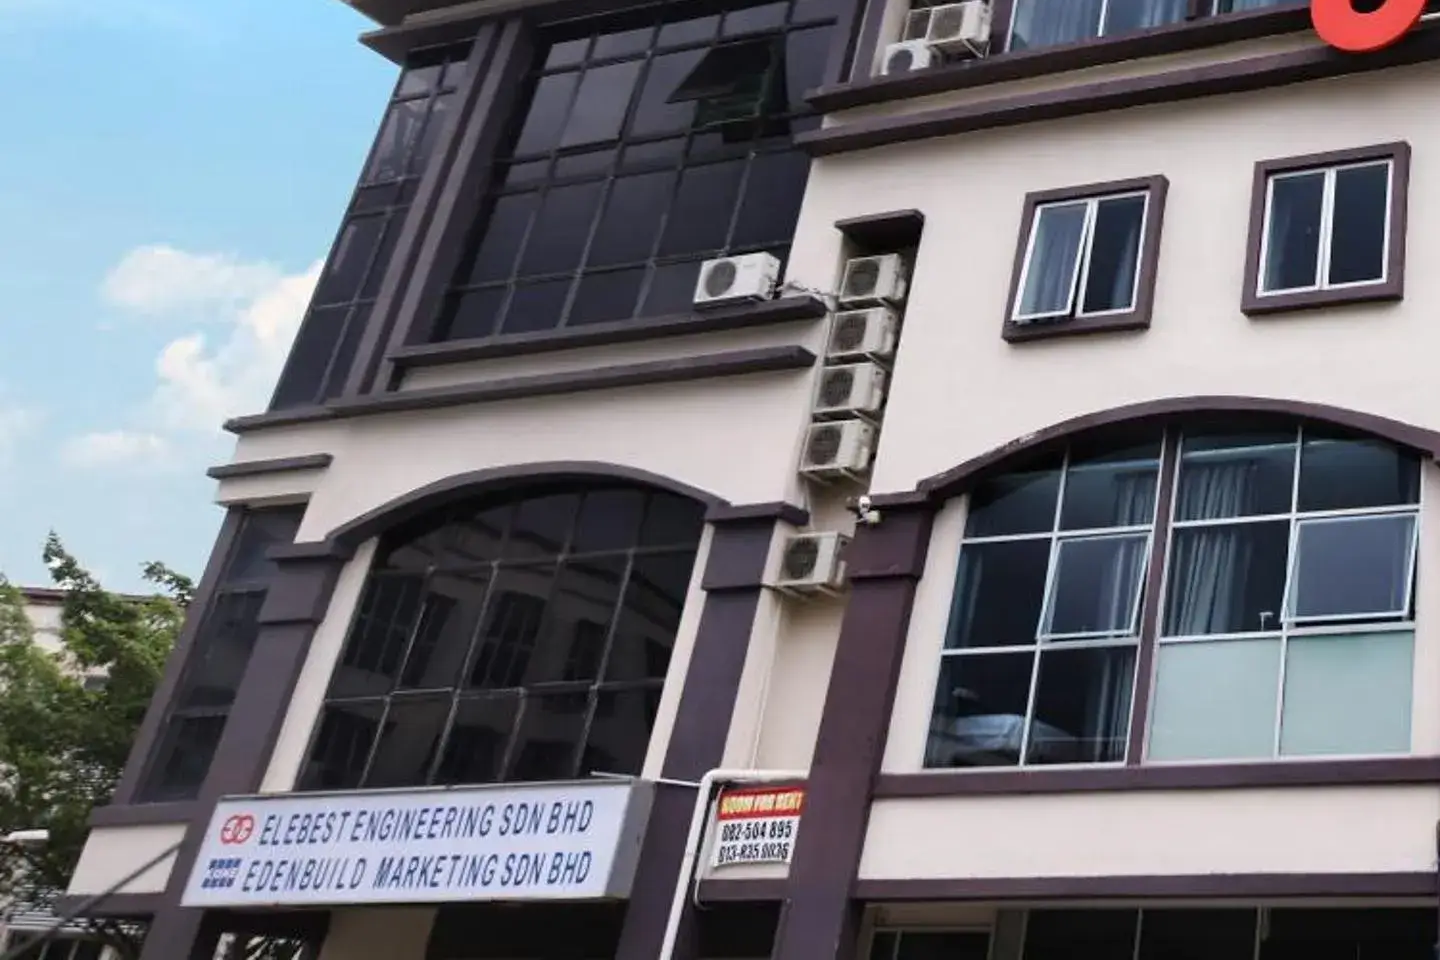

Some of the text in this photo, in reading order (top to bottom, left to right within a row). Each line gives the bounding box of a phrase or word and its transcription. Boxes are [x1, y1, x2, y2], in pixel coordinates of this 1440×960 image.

[258, 800, 595, 846] ELEBEST ENGINEERING SDN BHD
[769, 820, 792, 838] 895
[241, 851, 593, 892] EDENBUILD MARKETING SDN BHD
